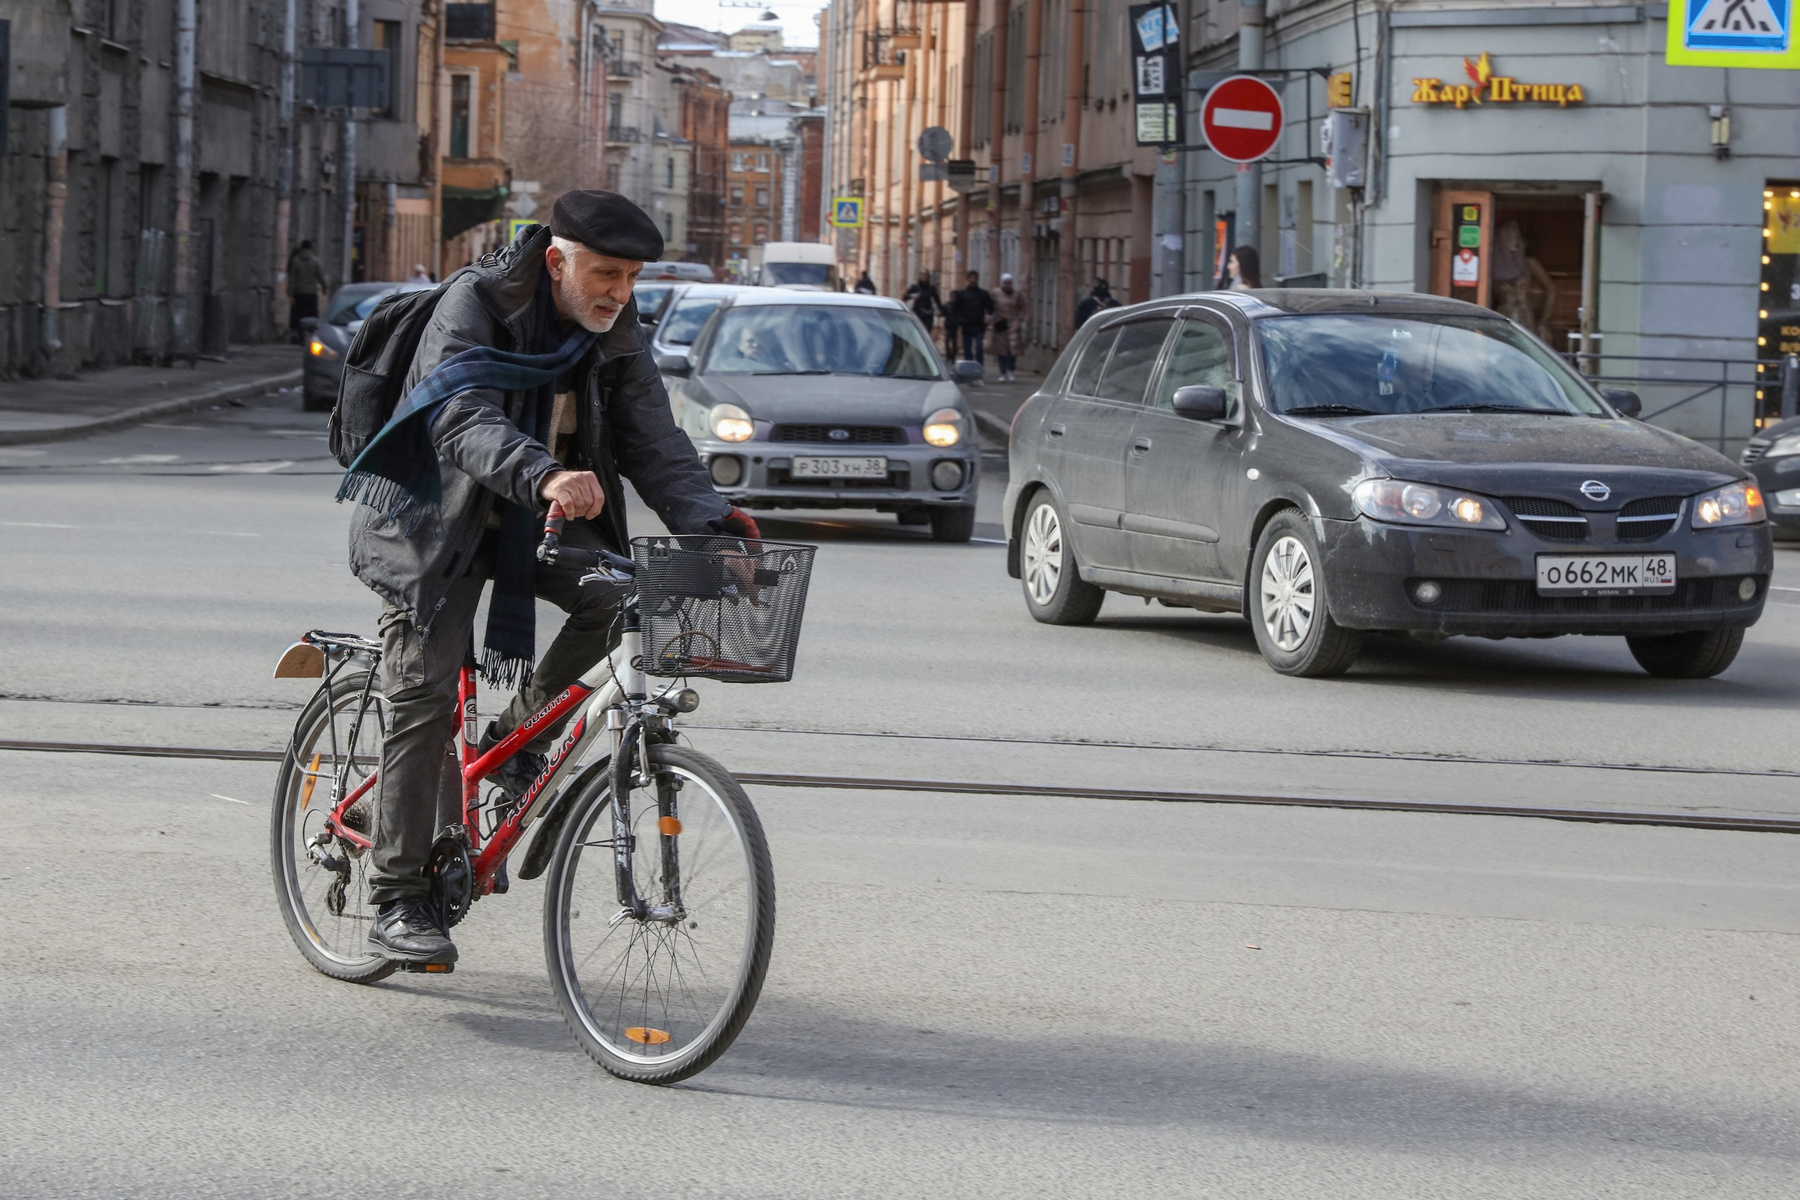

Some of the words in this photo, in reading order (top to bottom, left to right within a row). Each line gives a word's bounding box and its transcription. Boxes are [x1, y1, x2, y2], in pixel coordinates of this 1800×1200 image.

[1411, 78, 1470, 109] Жар
[1489, 77, 1585, 107] Птица
[864, 459, 881, 471] 38
[1645, 558, 1667, 576] 48
